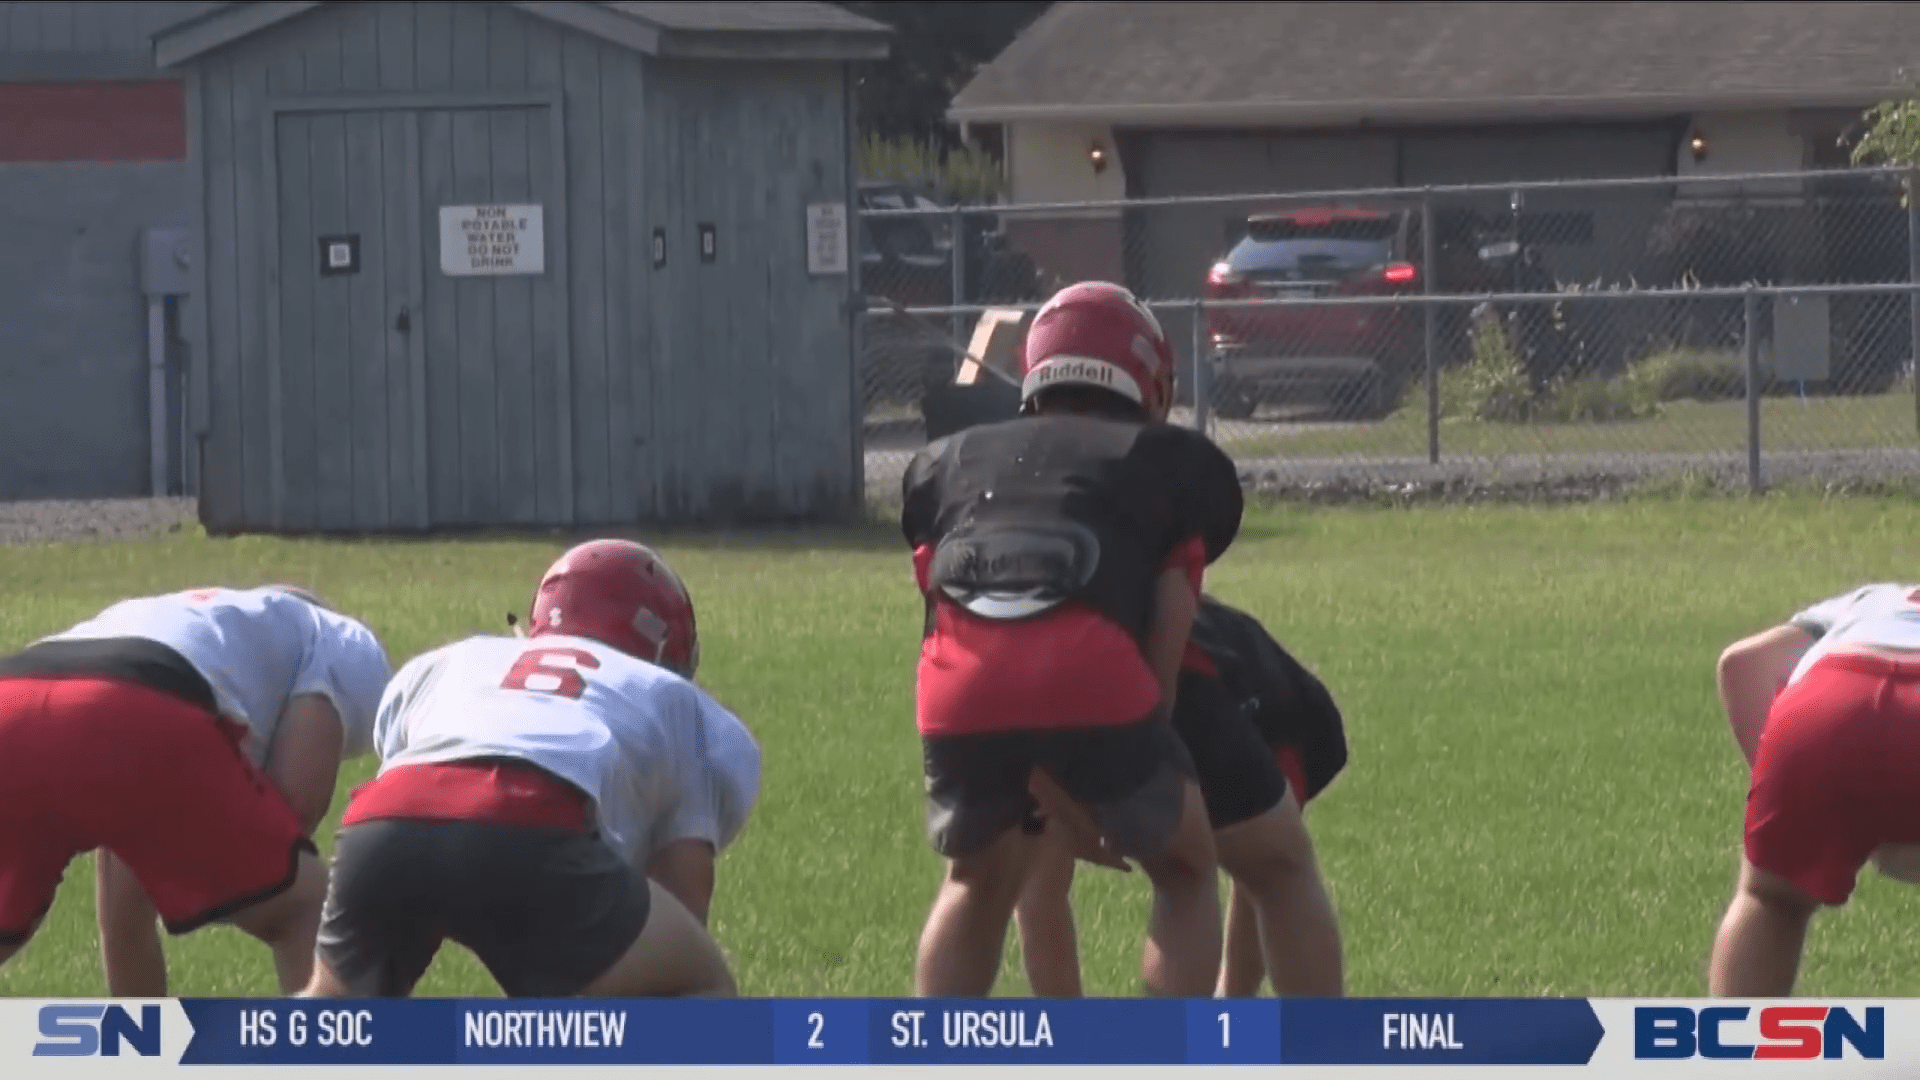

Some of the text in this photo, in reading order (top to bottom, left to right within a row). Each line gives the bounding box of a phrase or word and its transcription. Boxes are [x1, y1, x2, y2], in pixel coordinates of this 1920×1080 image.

[476, 207, 506, 218] NON
[466, 232, 516, 243] WATER
[468, 244, 519, 256] DO NOT
[470, 257, 514, 269] DRINK
[1038, 362, 1114, 384] Riddell
[500, 648, 602, 701] 6
